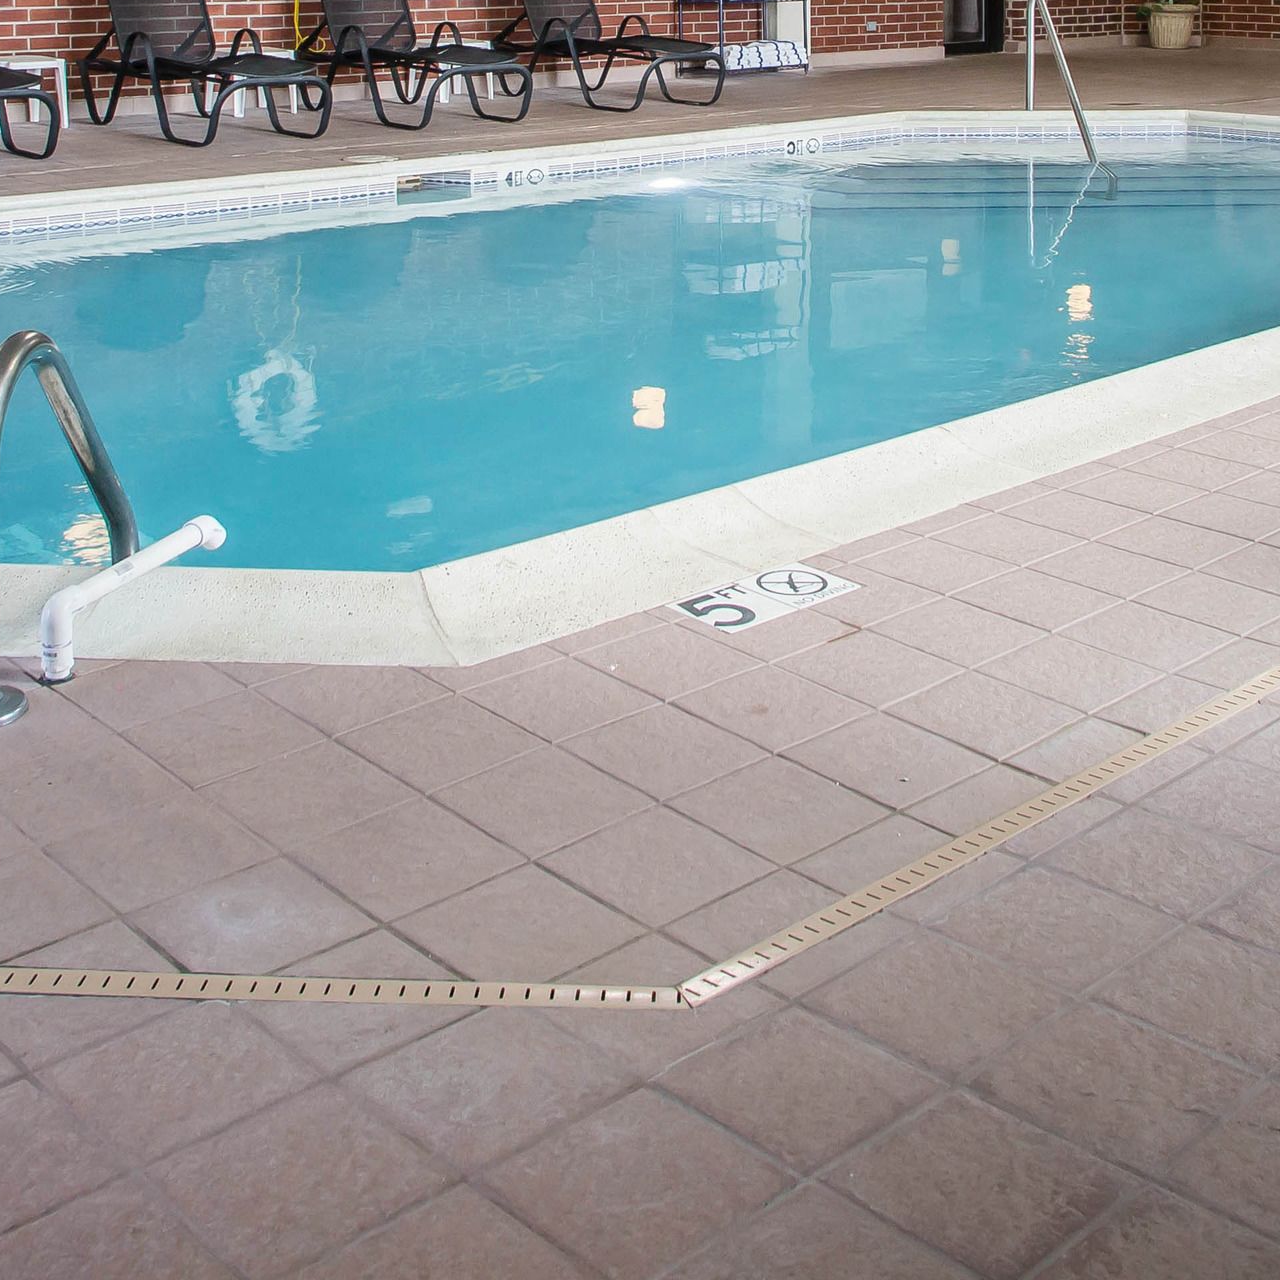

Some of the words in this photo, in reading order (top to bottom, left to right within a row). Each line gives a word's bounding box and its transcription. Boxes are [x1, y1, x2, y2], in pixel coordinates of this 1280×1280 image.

[713, 583, 747, 600] FT
[792, 596, 815, 607] NO
[813, 583, 855, 599] DIVING
[677, 594, 756, 627] 5
